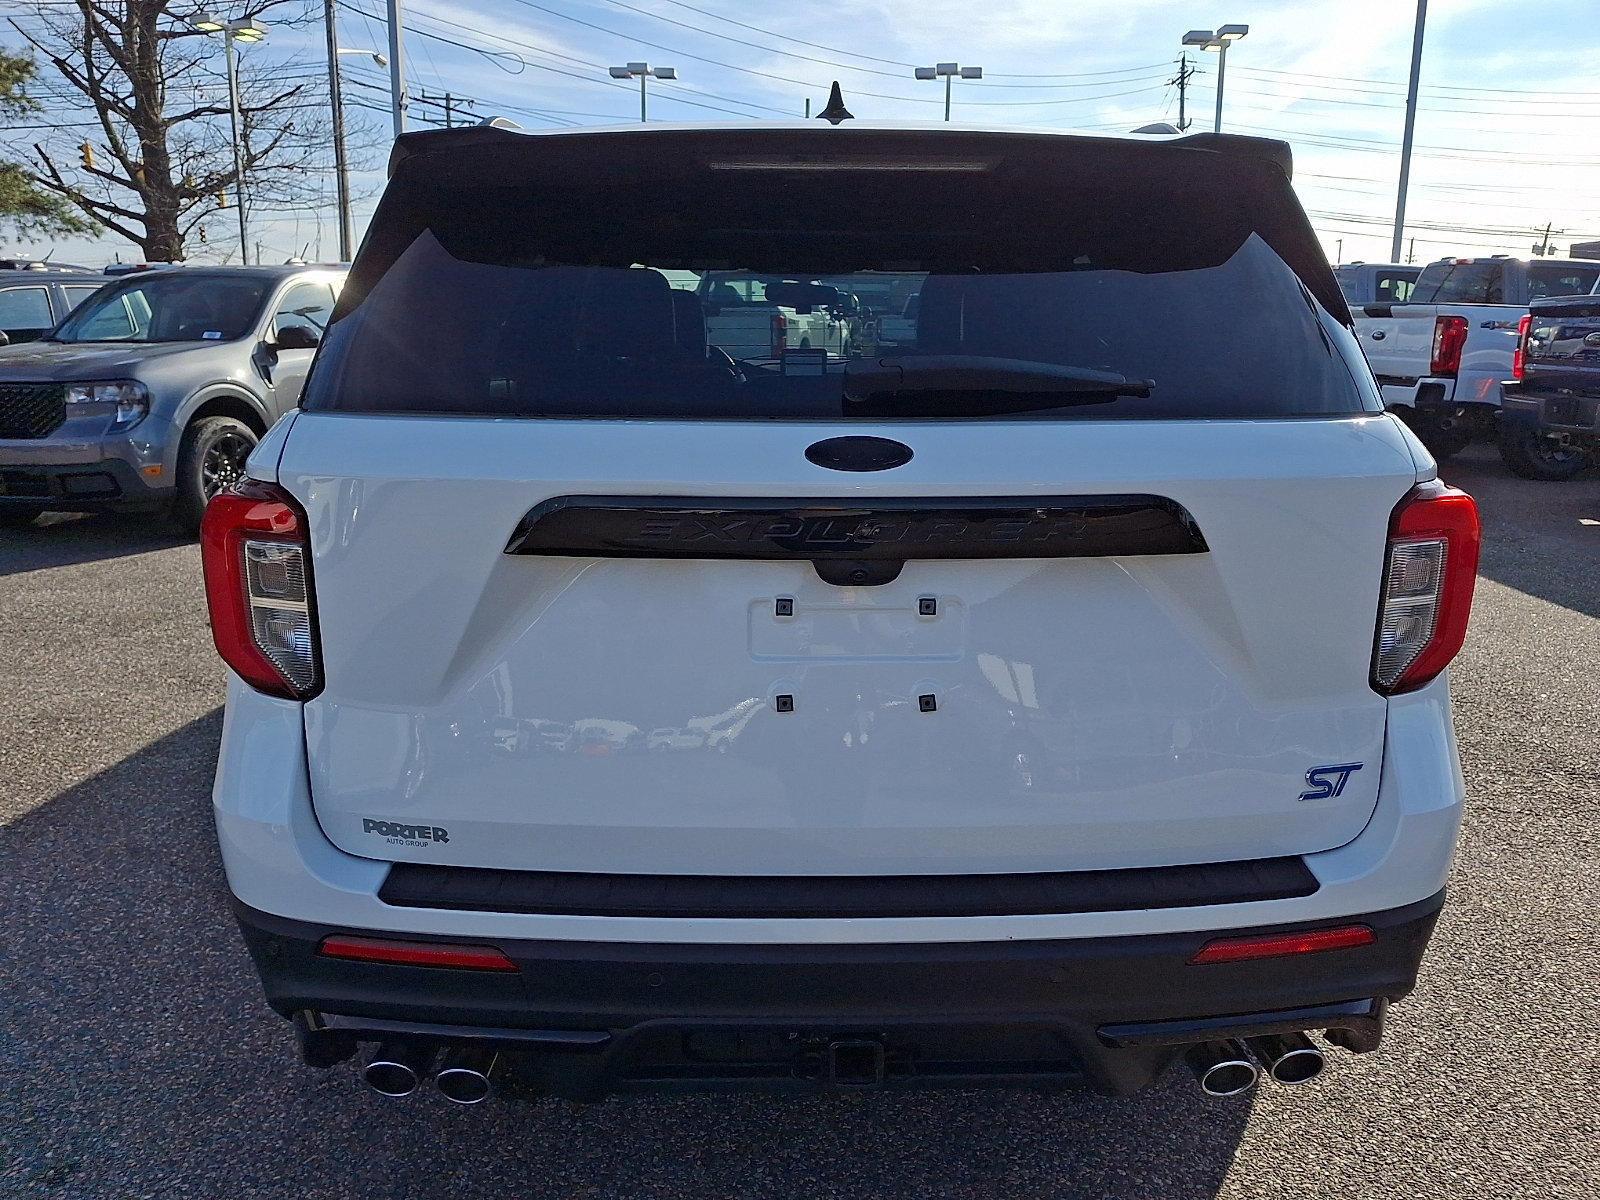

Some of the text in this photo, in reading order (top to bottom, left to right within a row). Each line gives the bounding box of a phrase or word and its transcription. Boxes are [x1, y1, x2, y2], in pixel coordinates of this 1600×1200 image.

[624, 518, 1088, 543] EXPLORER
[1298, 761, 1364, 801] ST
[363, 818, 450, 844] PORTER
[386, 838, 429, 848] AUTO GROUP
